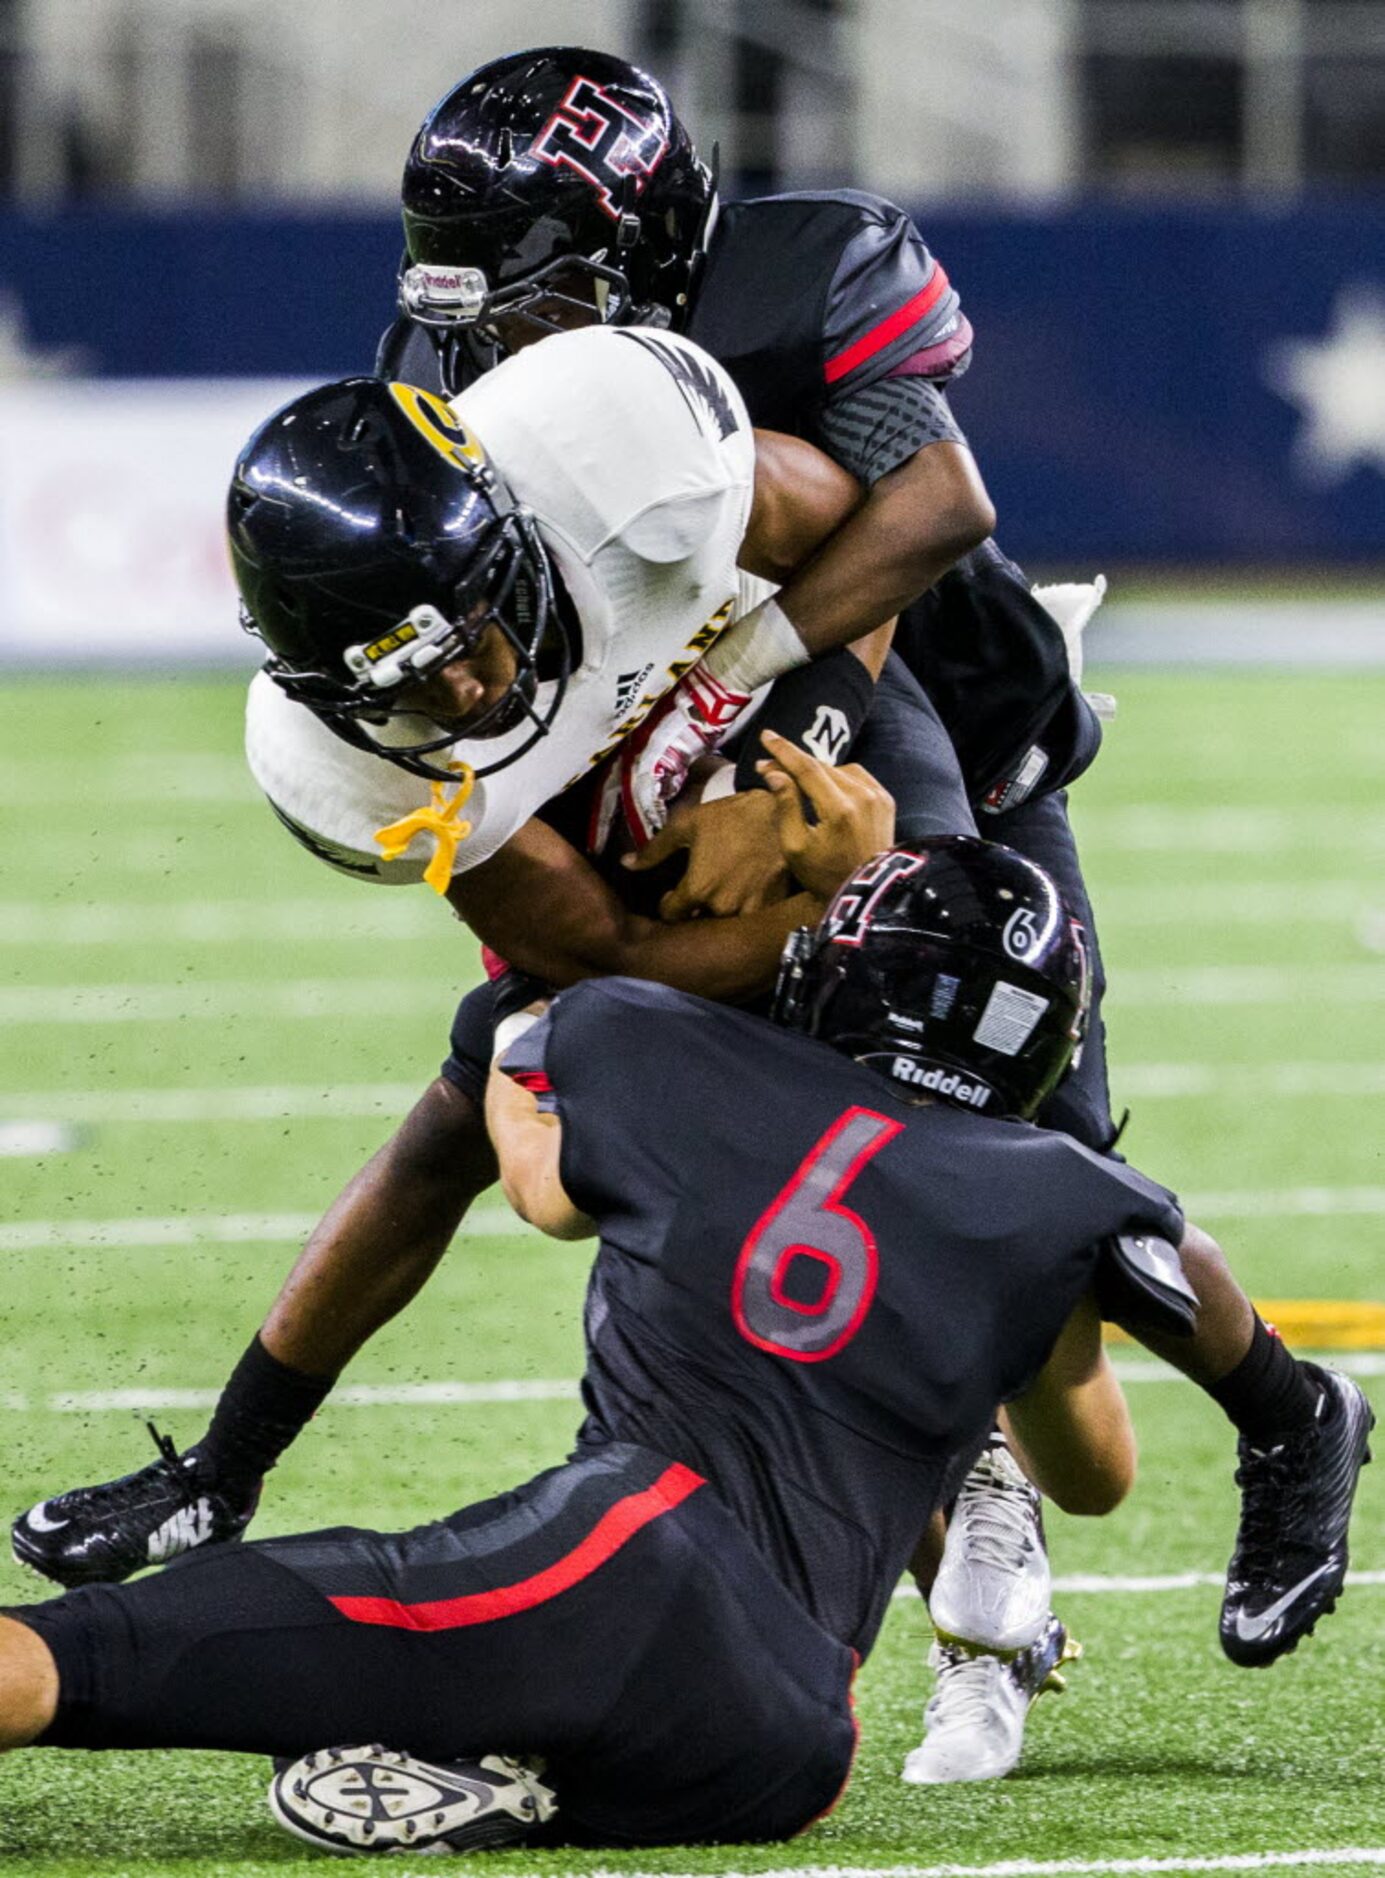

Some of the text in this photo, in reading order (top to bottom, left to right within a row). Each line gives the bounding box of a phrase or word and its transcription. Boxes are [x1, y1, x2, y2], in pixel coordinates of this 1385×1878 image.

[614, 662, 656, 719] adidas
[809, 711, 848, 759] N
[1003, 907, 1040, 964] 6
[892, 1056, 992, 1108] Riddell
[731, 1105, 906, 1363] 6
[147, 1496, 214, 1563] NIKE
